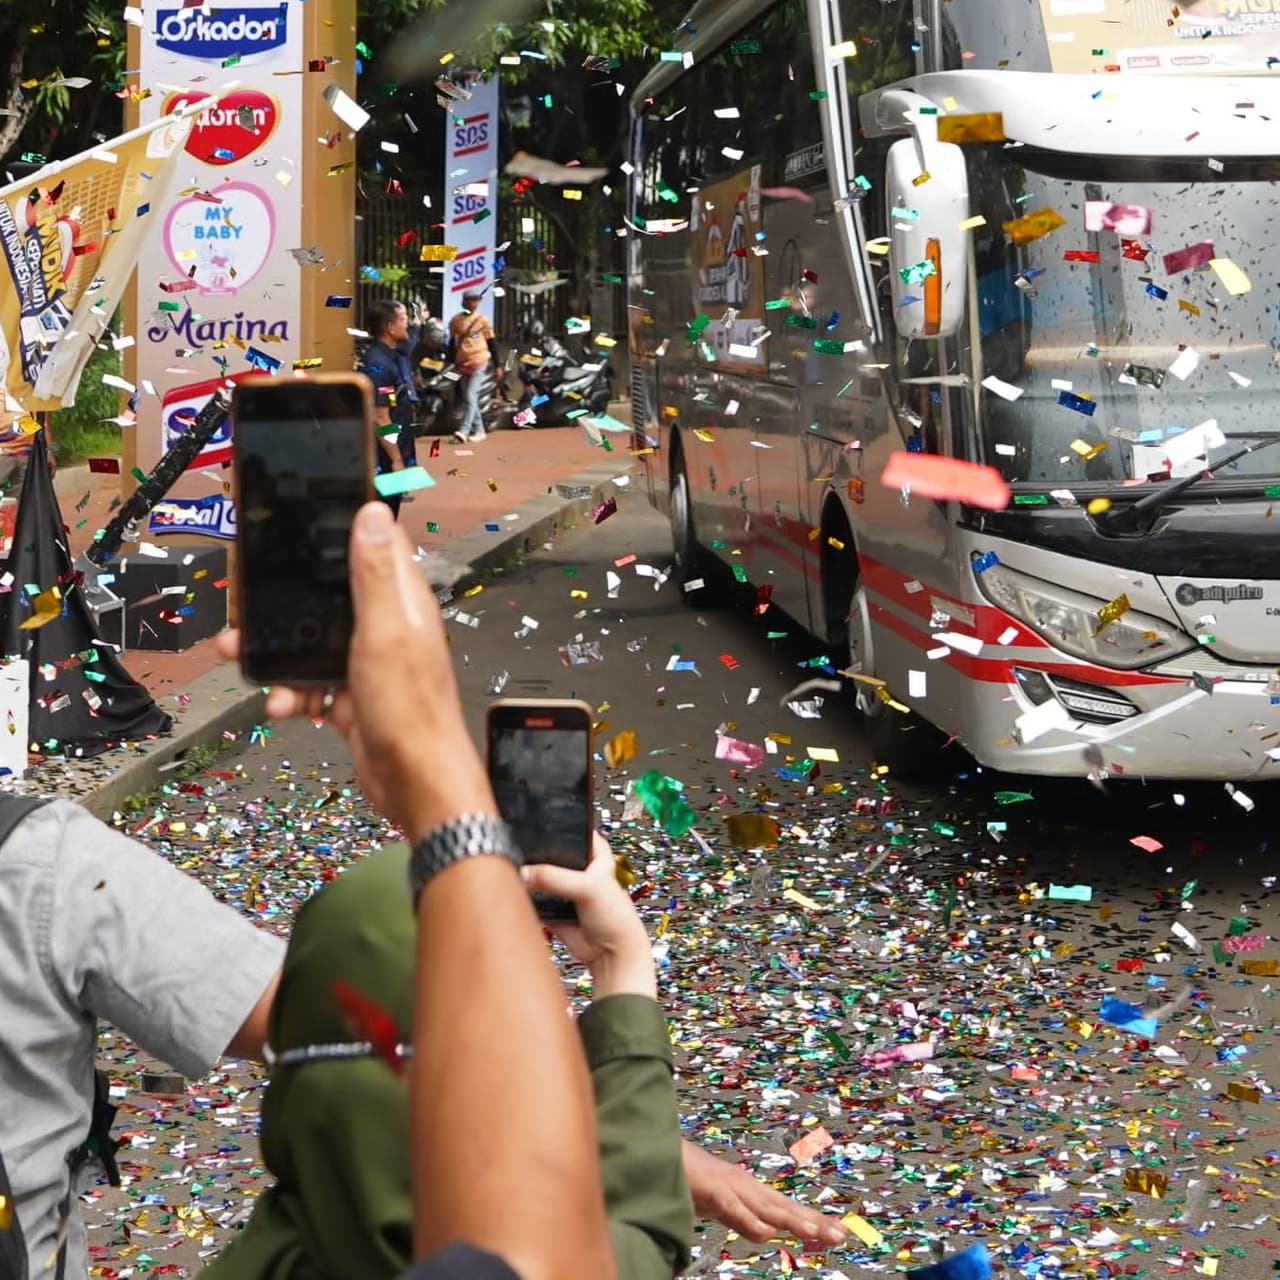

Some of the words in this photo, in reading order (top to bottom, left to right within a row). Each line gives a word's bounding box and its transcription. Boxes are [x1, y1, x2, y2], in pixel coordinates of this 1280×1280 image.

[162, 14, 277, 41] Oskadon
[205, 206, 233, 221] MY
[194, 225, 243, 239] BABY
[148, 307, 289, 349] Marina
